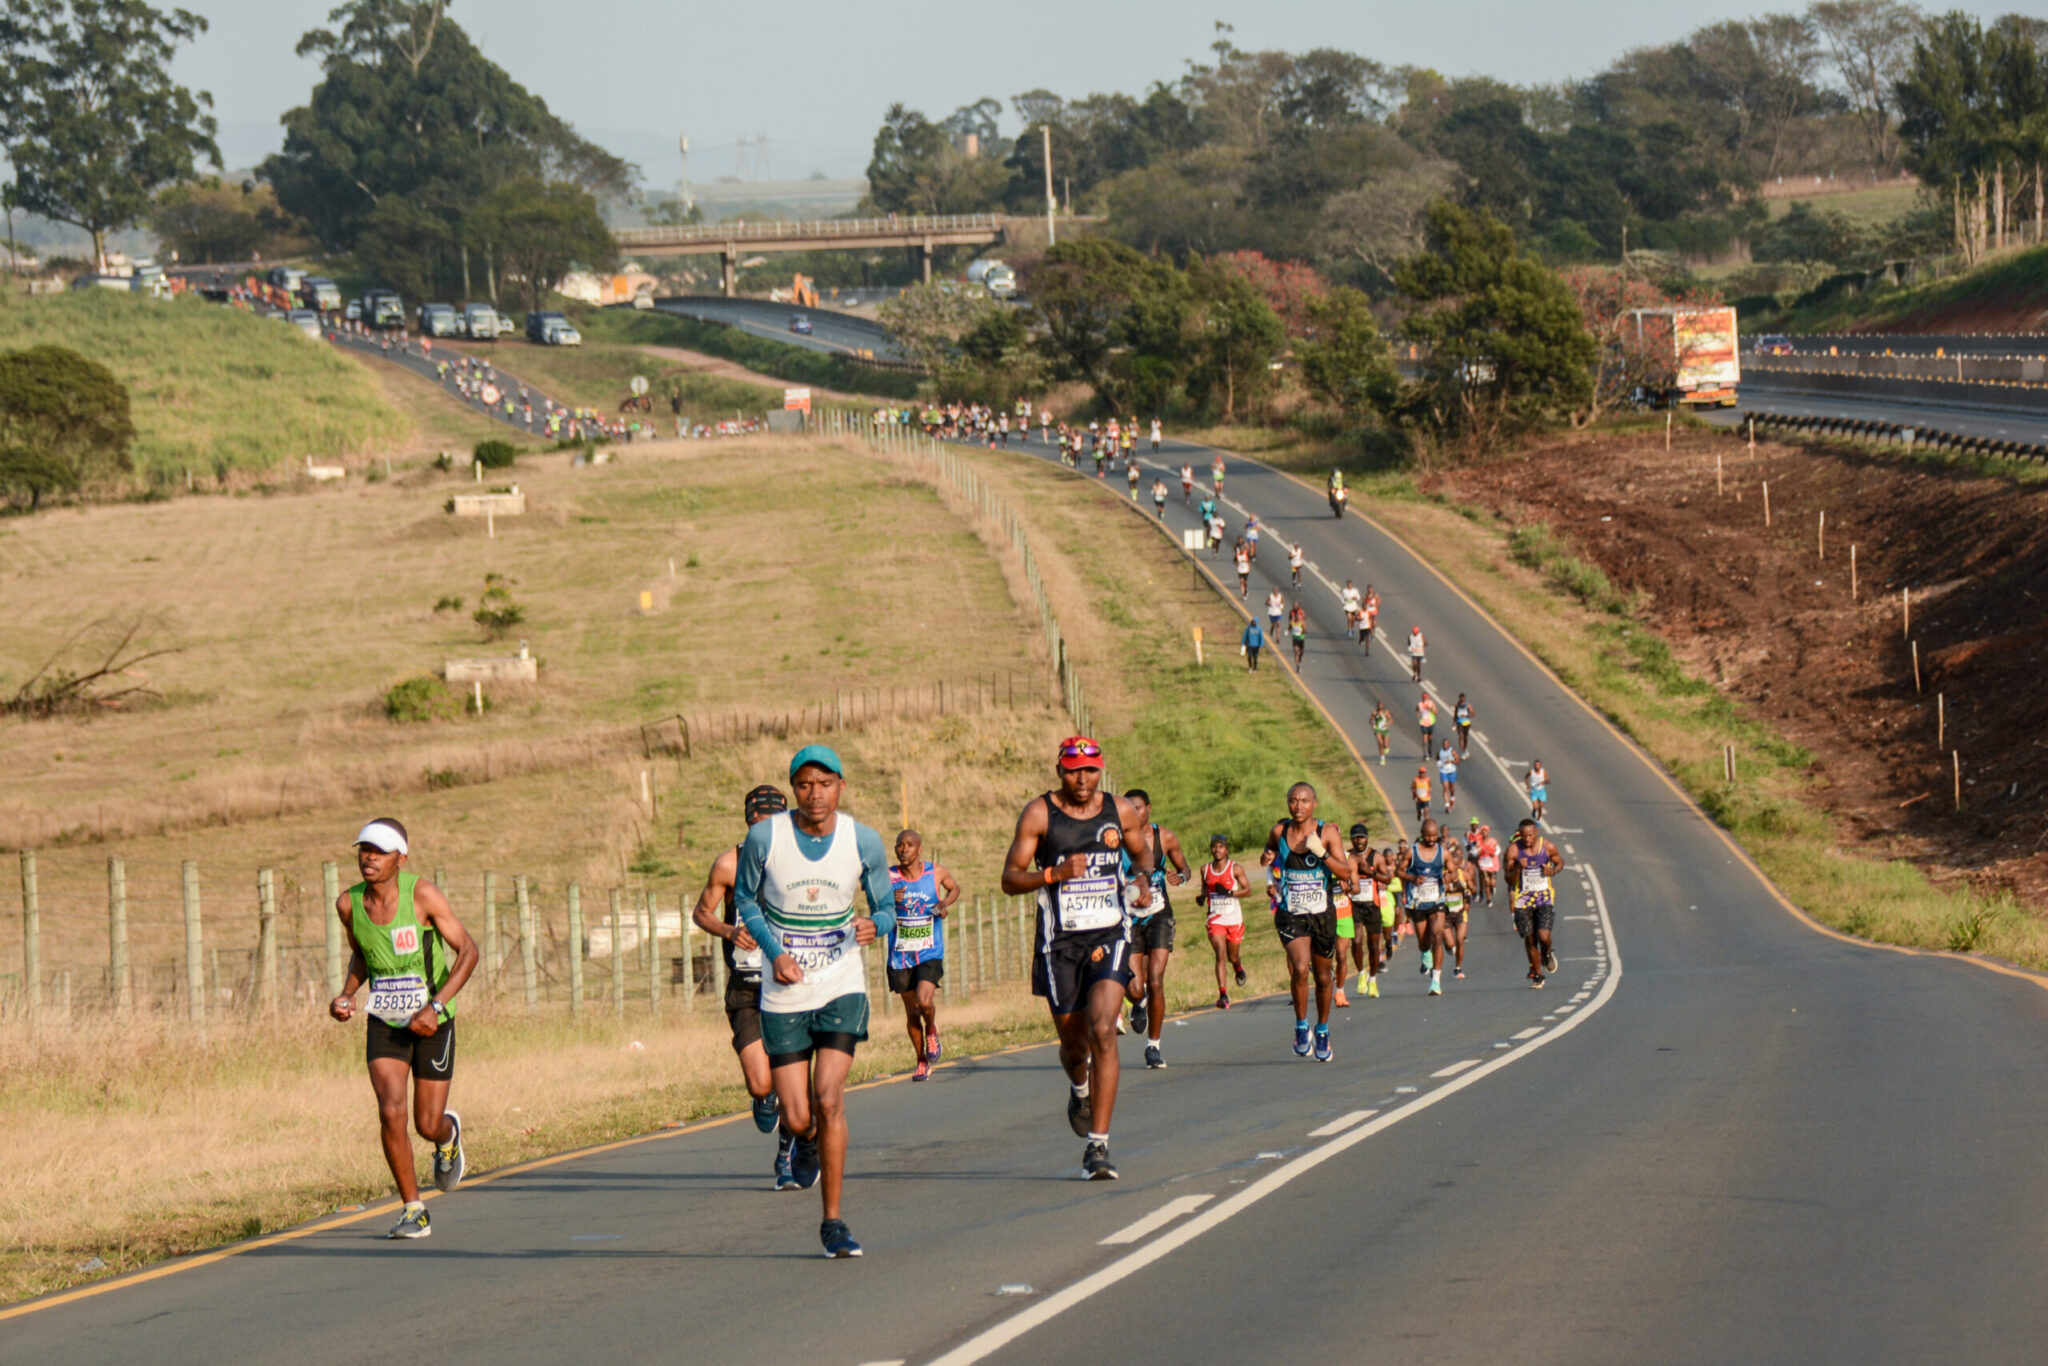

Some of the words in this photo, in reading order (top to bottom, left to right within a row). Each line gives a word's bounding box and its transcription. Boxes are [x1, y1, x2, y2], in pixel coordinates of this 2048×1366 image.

[1056, 851, 1119, 866] AYENI
[786, 878, 839, 890] CORRECTIONAL
[1070, 881, 1109, 892] HOLLYWOOD
[797, 904, 828, 912] SERVICES
[1066, 894, 1113, 912] A57776
[395, 930, 415, 950] 40
[792, 936, 838, 947] HOLLYWOOD
[376, 979, 416, 990] HOLLYWOOD
[373, 993, 422, 1010] B58325
